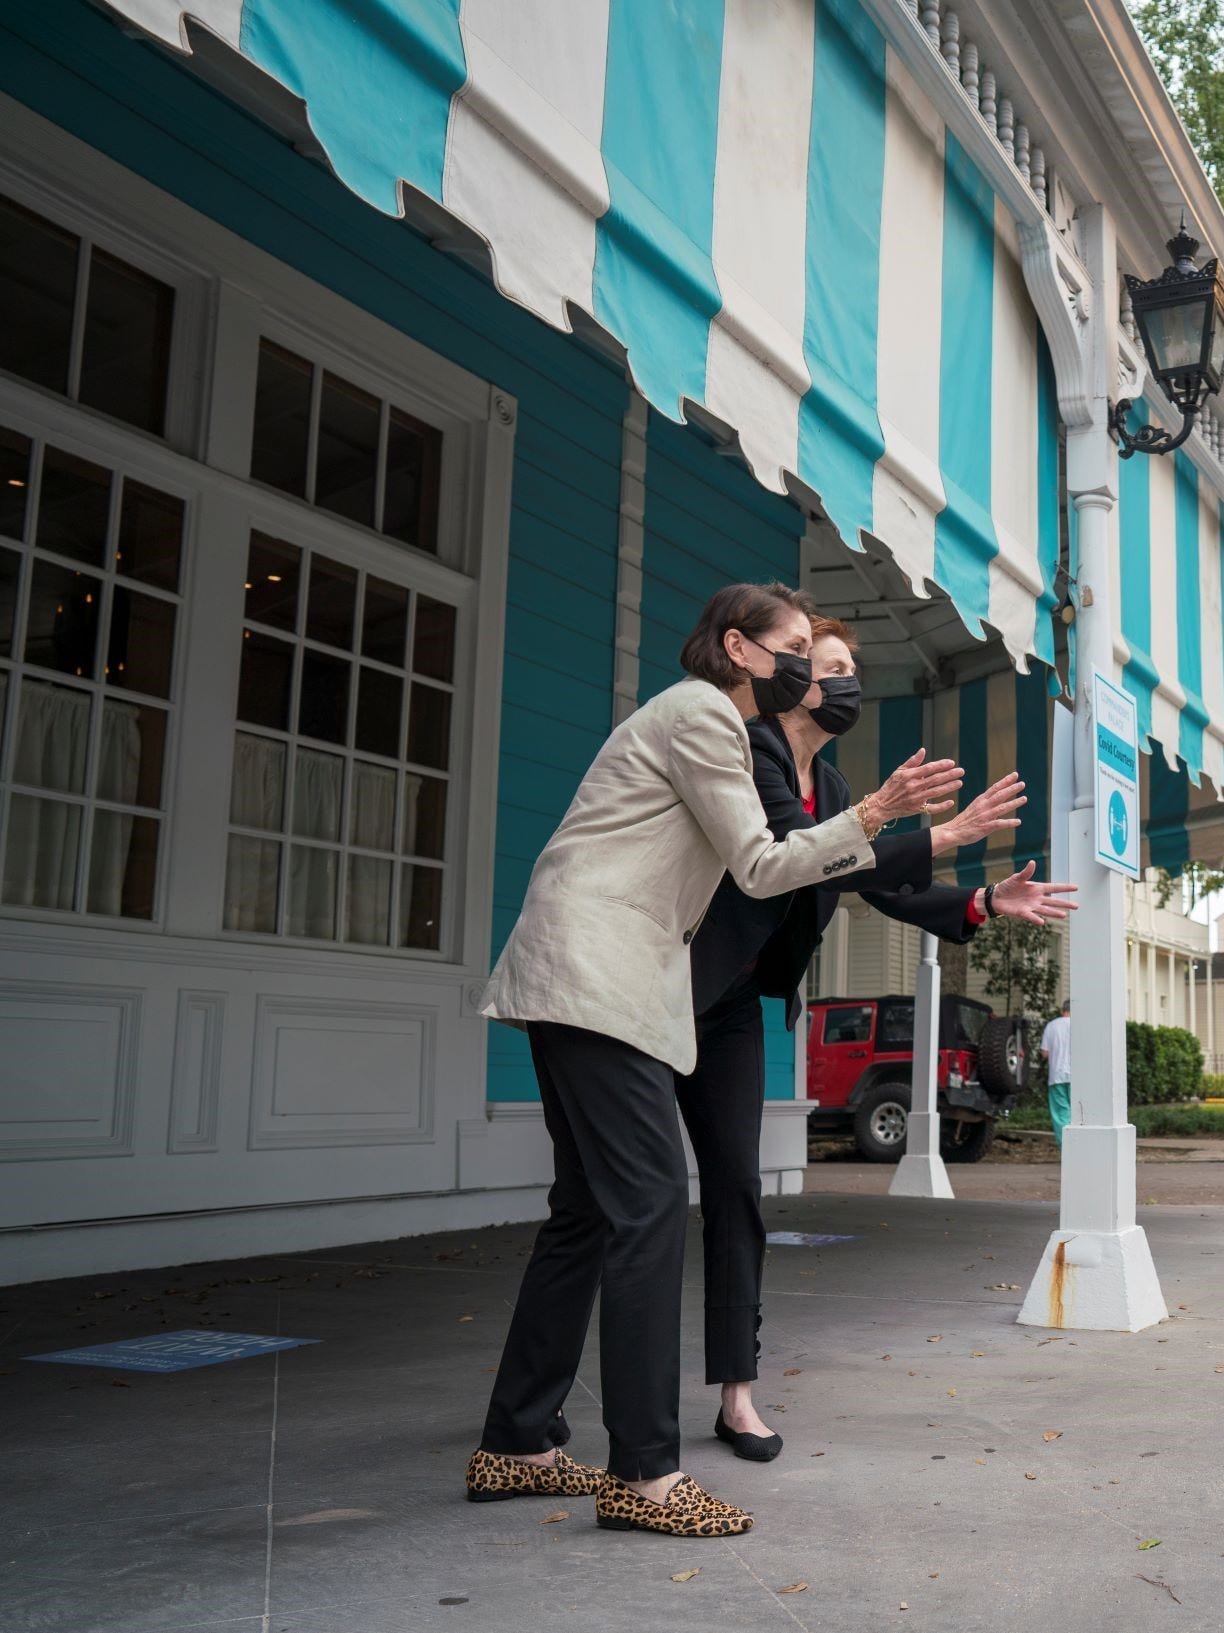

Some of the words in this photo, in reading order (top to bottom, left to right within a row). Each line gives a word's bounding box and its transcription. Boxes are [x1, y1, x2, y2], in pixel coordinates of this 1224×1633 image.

[1098, 734, 1113, 755] Covid
[1113, 745, 1135, 772] Courtesy
[166, 1331, 294, 1347] HERE
[118, 1341, 244, 1357] WAIT
